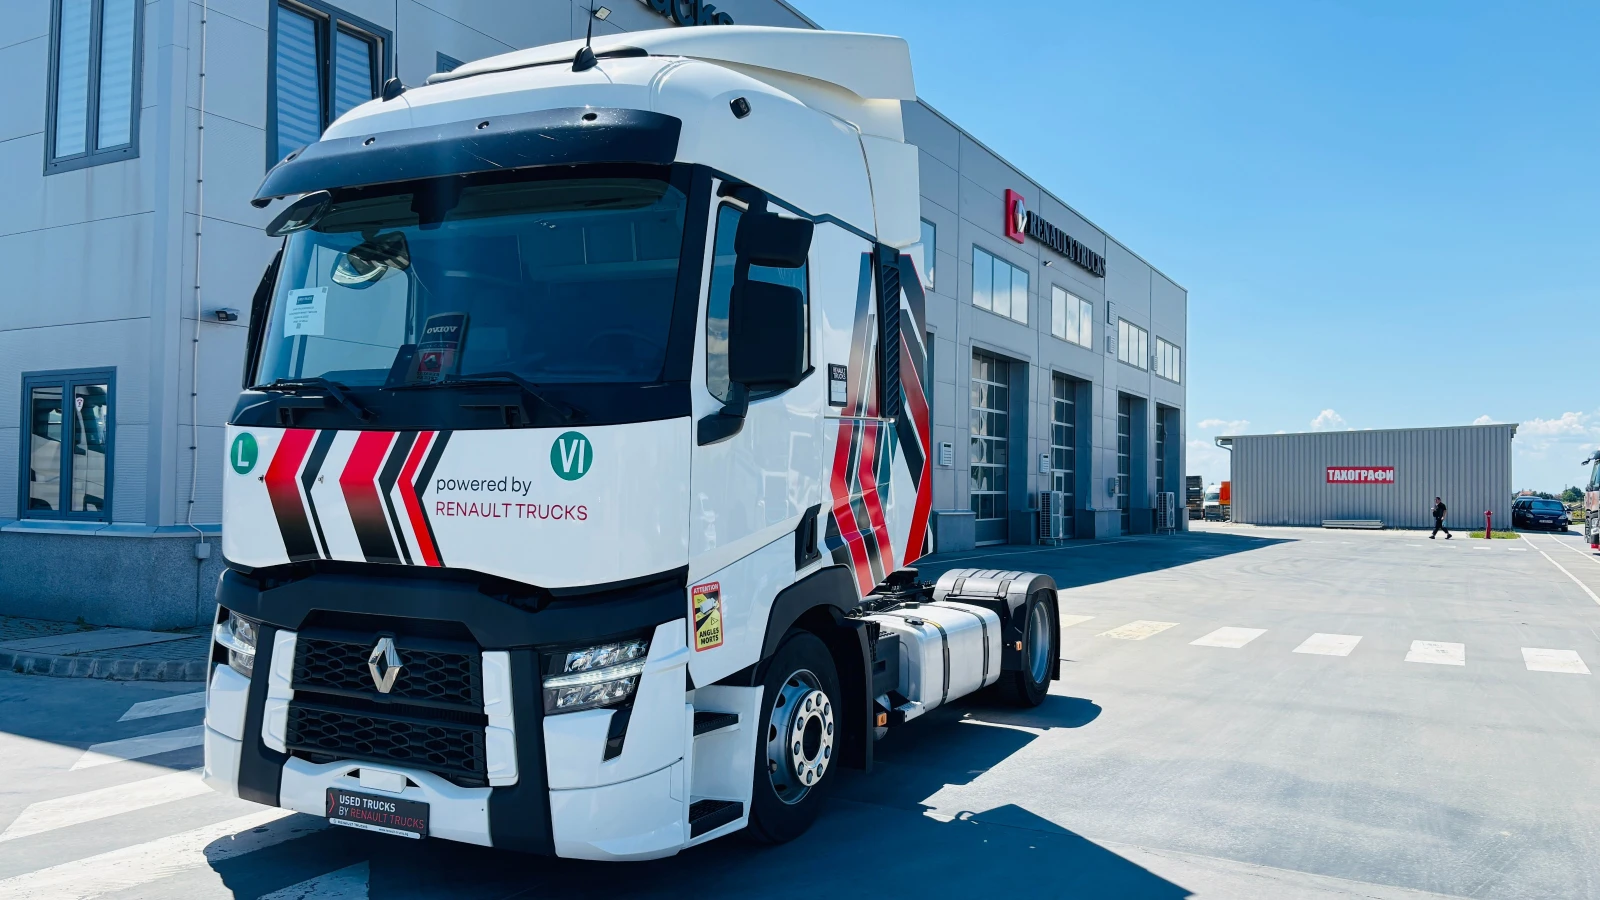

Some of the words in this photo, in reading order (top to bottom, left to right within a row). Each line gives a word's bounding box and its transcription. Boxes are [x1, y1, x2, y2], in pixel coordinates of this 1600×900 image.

[1027, 210, 1075, 261] RENAULT
[1075, 240, 1106, 278] TRUCKS
[237, 439, 250, 467] L
[558, 438, 586, 474] VI
[1327, 469, 1394, 481] ТАХОГРАФИ
[436, 476, 507, 494] powered
[511, 476, 532, 497] by
[436, 501, 512, 518] RENAULT
[515, 503, 588, 521] TRUCKS
[693, 583, 719, 594] ATTENTION
[699, 627, 719, 638] ANGLES
[700, 634, 719, 645] MORTS
[339, 794, 361, 807] USED
[362, 798, 396, 813] TRUCKS
[338, 805, 349, 816] BY
[350, 808, 389, 823] RENAULT
[390, 814, 425, 829] TRUCKS
